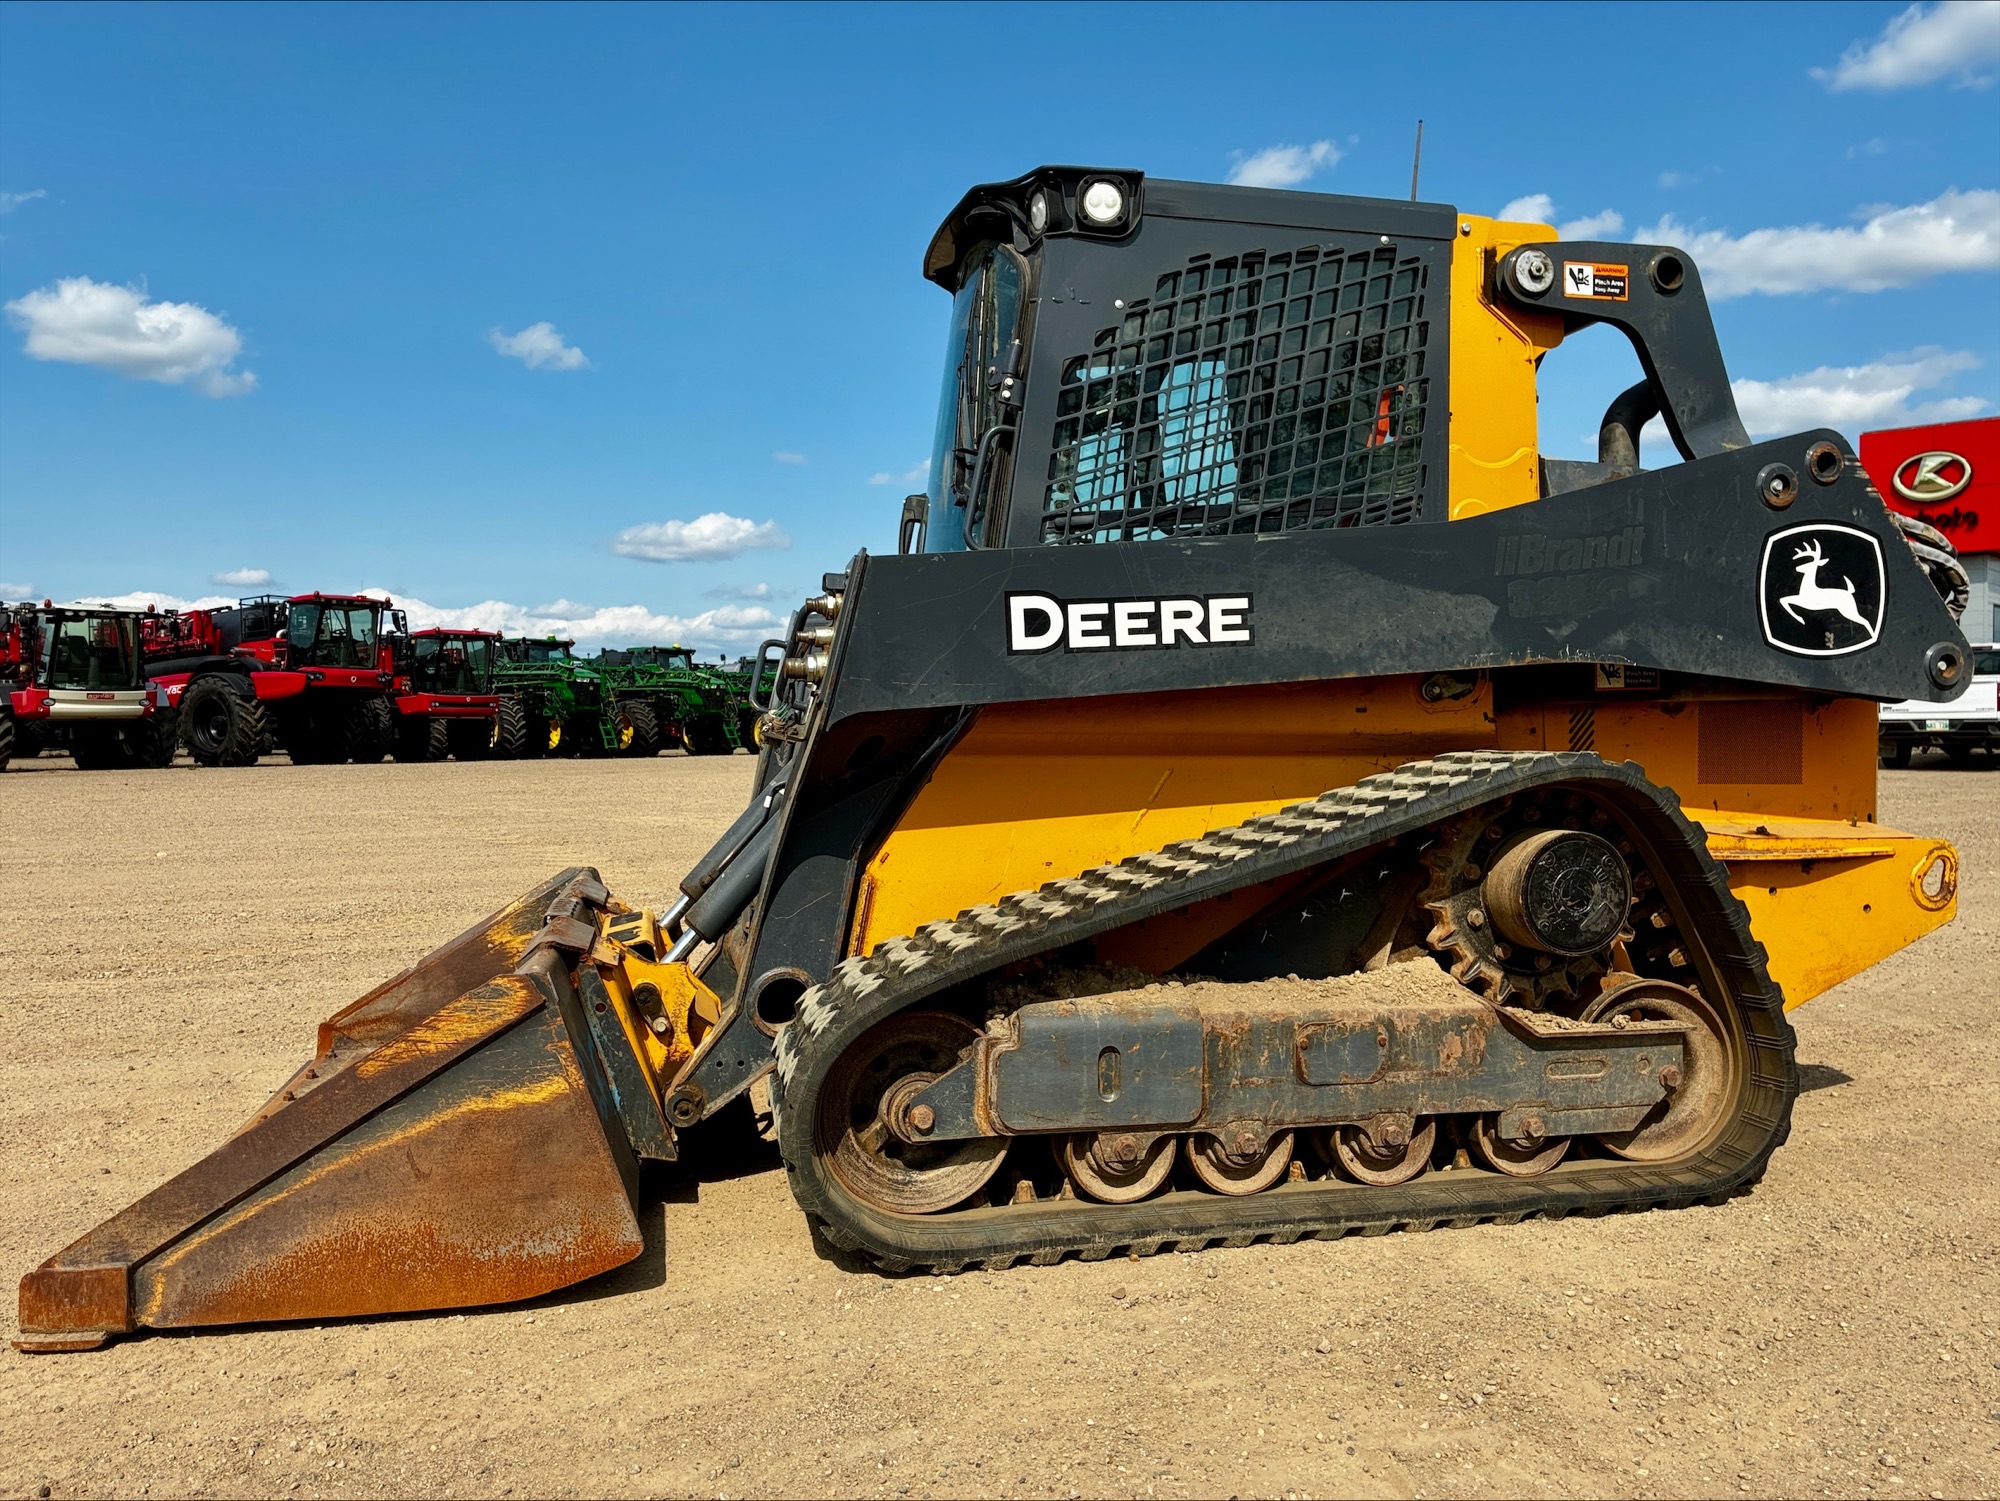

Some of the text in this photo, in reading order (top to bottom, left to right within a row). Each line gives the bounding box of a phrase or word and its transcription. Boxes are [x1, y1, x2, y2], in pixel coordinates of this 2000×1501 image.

[1595, 278, 1624, 287] Pinch Area
[1009, 594, 1251, 651] DEERE
